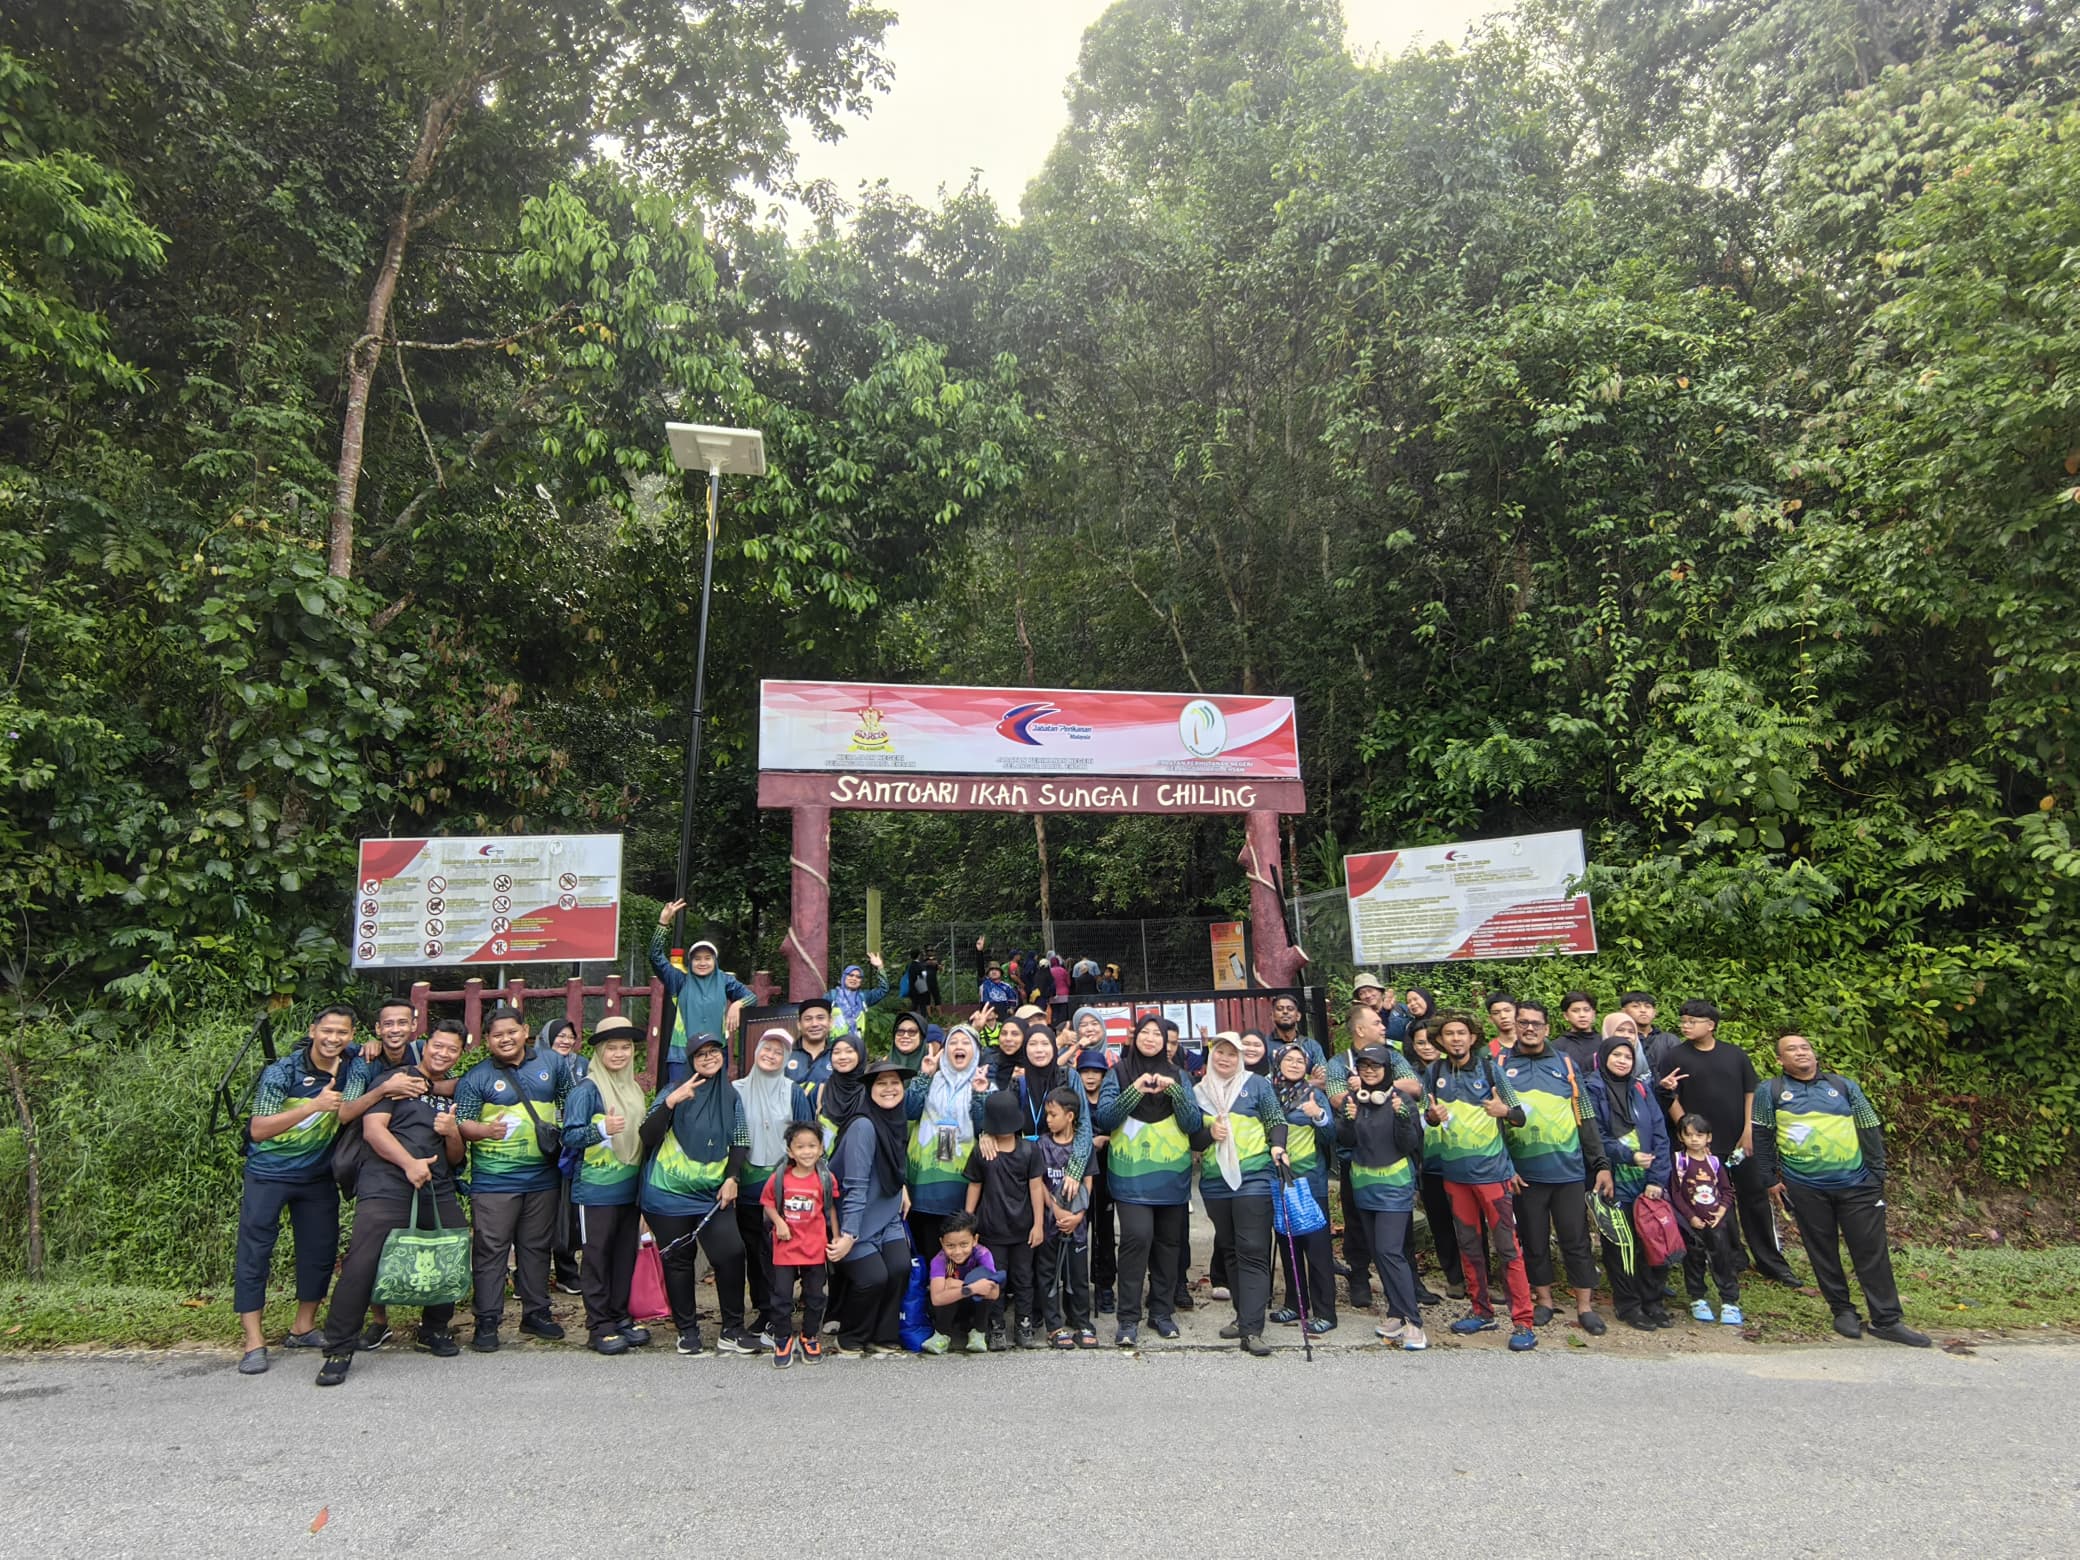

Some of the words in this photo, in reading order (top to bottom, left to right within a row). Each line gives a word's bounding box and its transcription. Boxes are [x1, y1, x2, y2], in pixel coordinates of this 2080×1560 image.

[1033, 724, 1058, 732] Jabatan
[1060, 725, 1092, 733] Perikanan
[830, 775, 959, 804] SANTUARI
[970, 782, 1029, 806] IKAN
[1038, 783, 1139, 808] SUNGAI
[1157, 784, 1257, 808] CHILING
